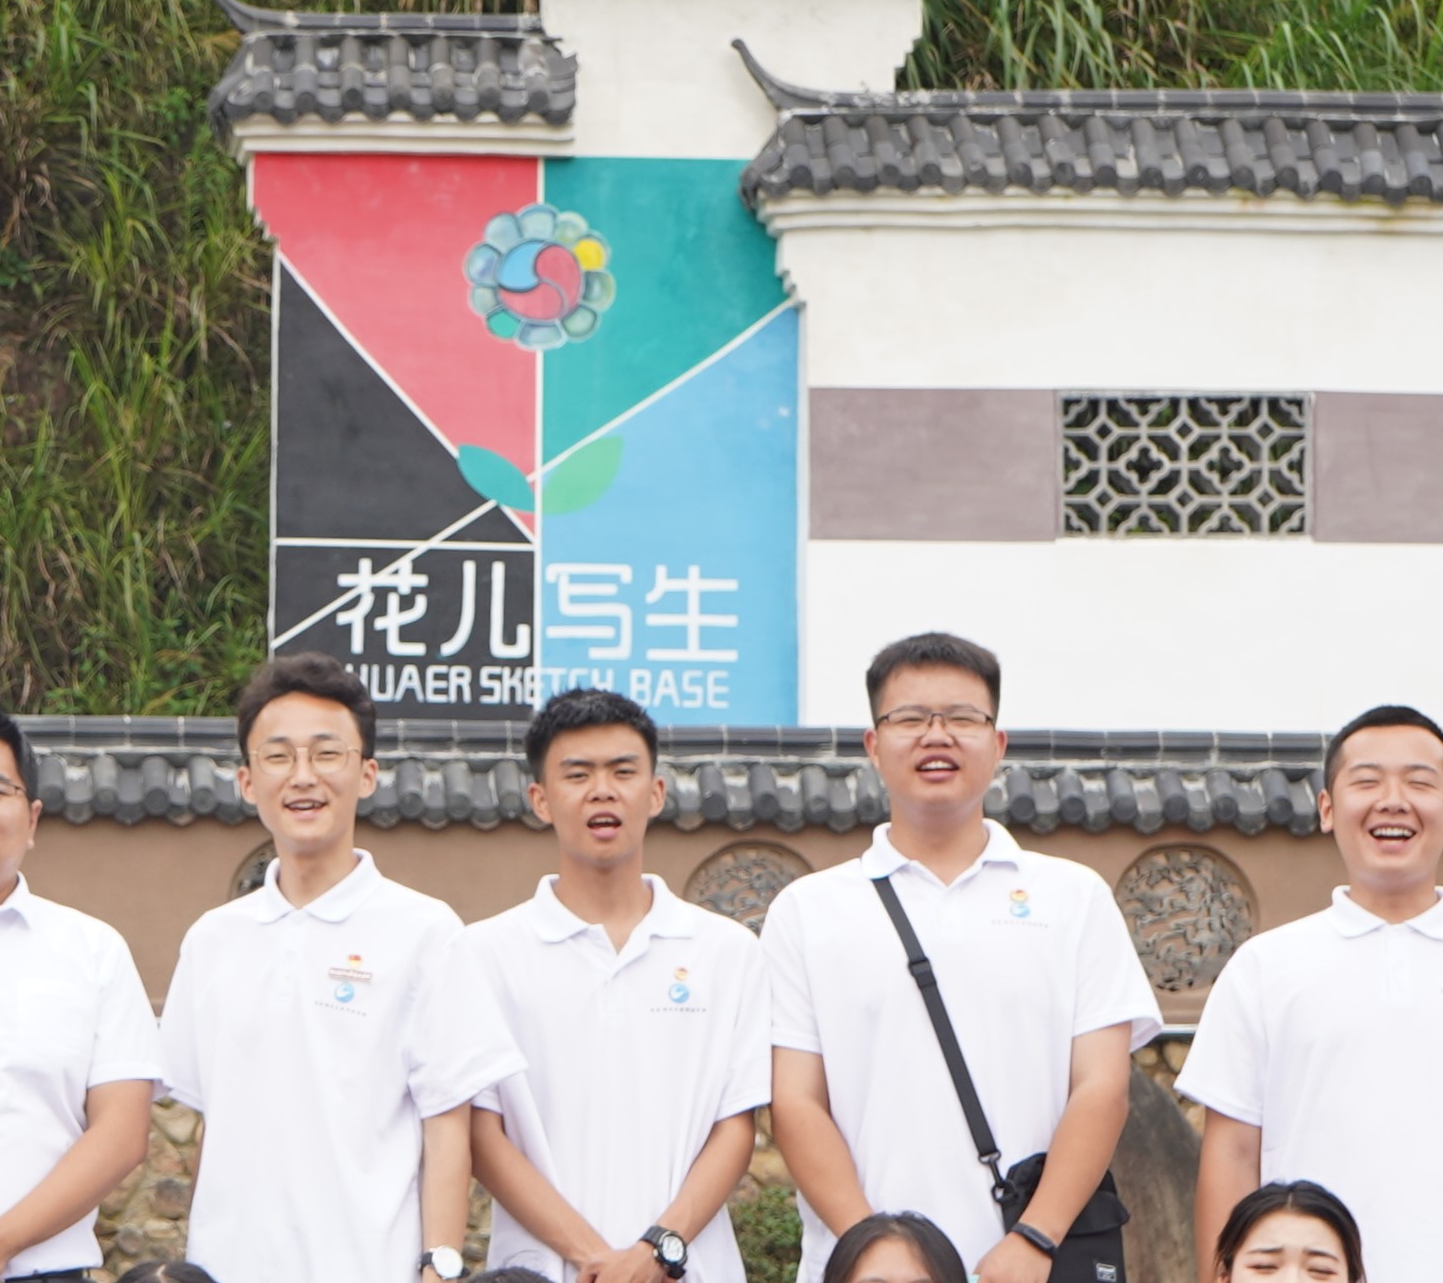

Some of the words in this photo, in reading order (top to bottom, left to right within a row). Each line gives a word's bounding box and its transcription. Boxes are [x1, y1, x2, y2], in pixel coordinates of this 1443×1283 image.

[335, 557, 739, 663] 花儿写生
[629, 668, 730, 709] BASE
